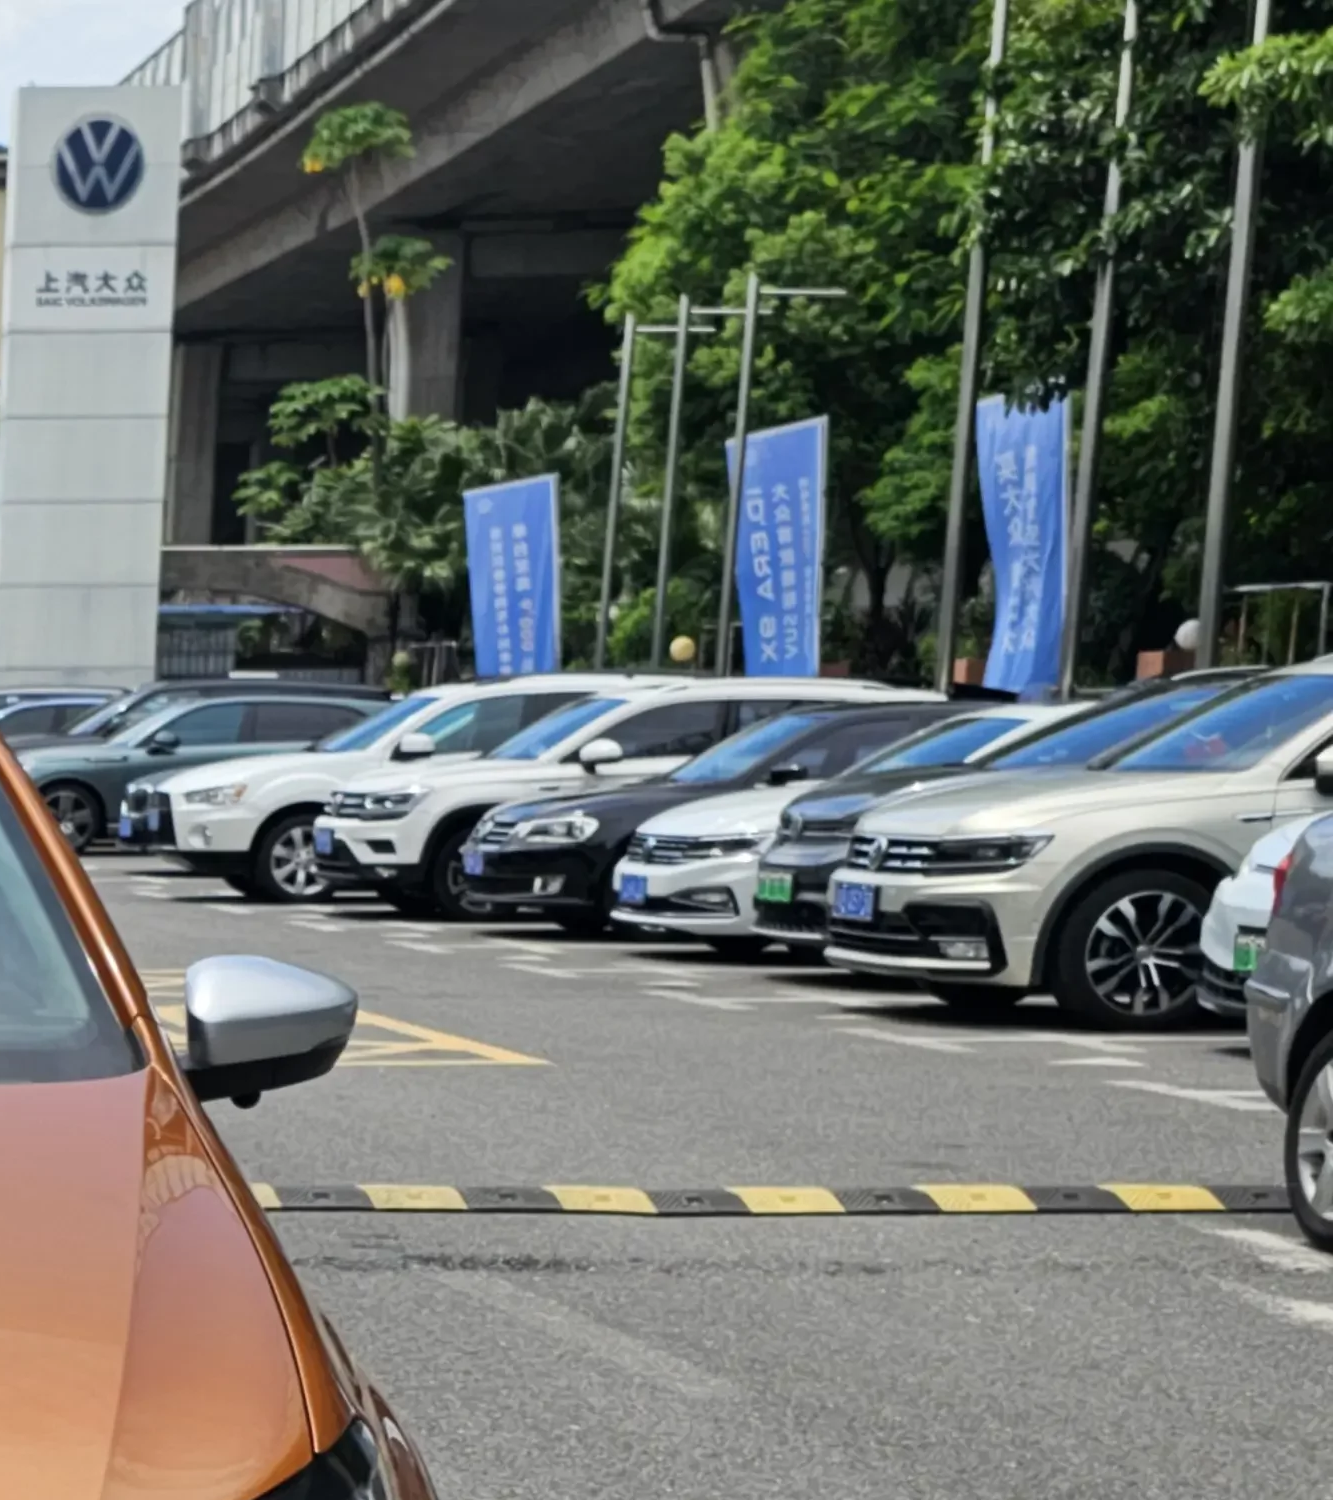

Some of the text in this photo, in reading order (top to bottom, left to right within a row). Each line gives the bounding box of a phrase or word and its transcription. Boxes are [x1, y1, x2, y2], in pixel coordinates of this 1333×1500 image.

[51, 114, 145, 214] VW
[36, 269, 147, 294] 上汽大众
